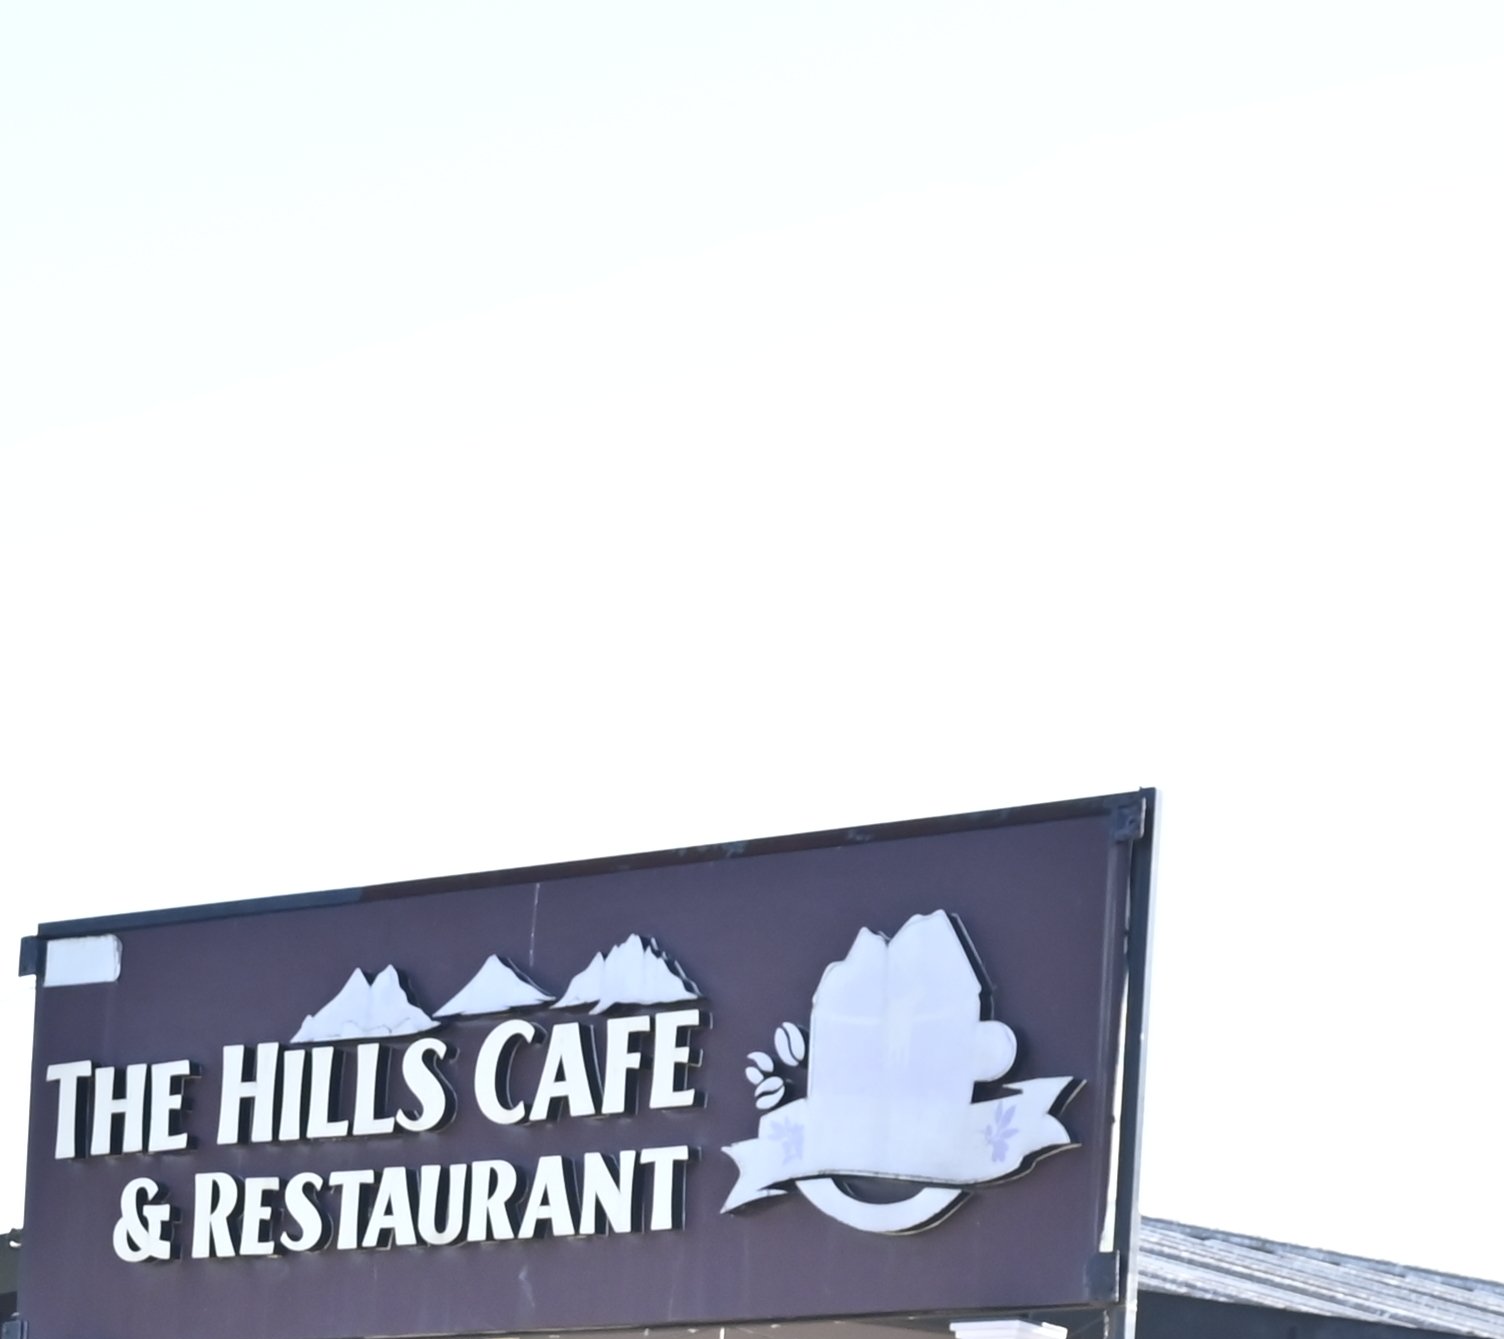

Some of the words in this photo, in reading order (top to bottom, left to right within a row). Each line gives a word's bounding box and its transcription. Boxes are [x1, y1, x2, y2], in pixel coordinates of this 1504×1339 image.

[46, 1060, 191, 1160] THE
[217, 1037, 448, 1145] HILLS
[474, 1009, 700, 1125] CAFE
[113, 1177, 171, 1263] &
[192, 1145, 689, 1259] RESTAURANT
